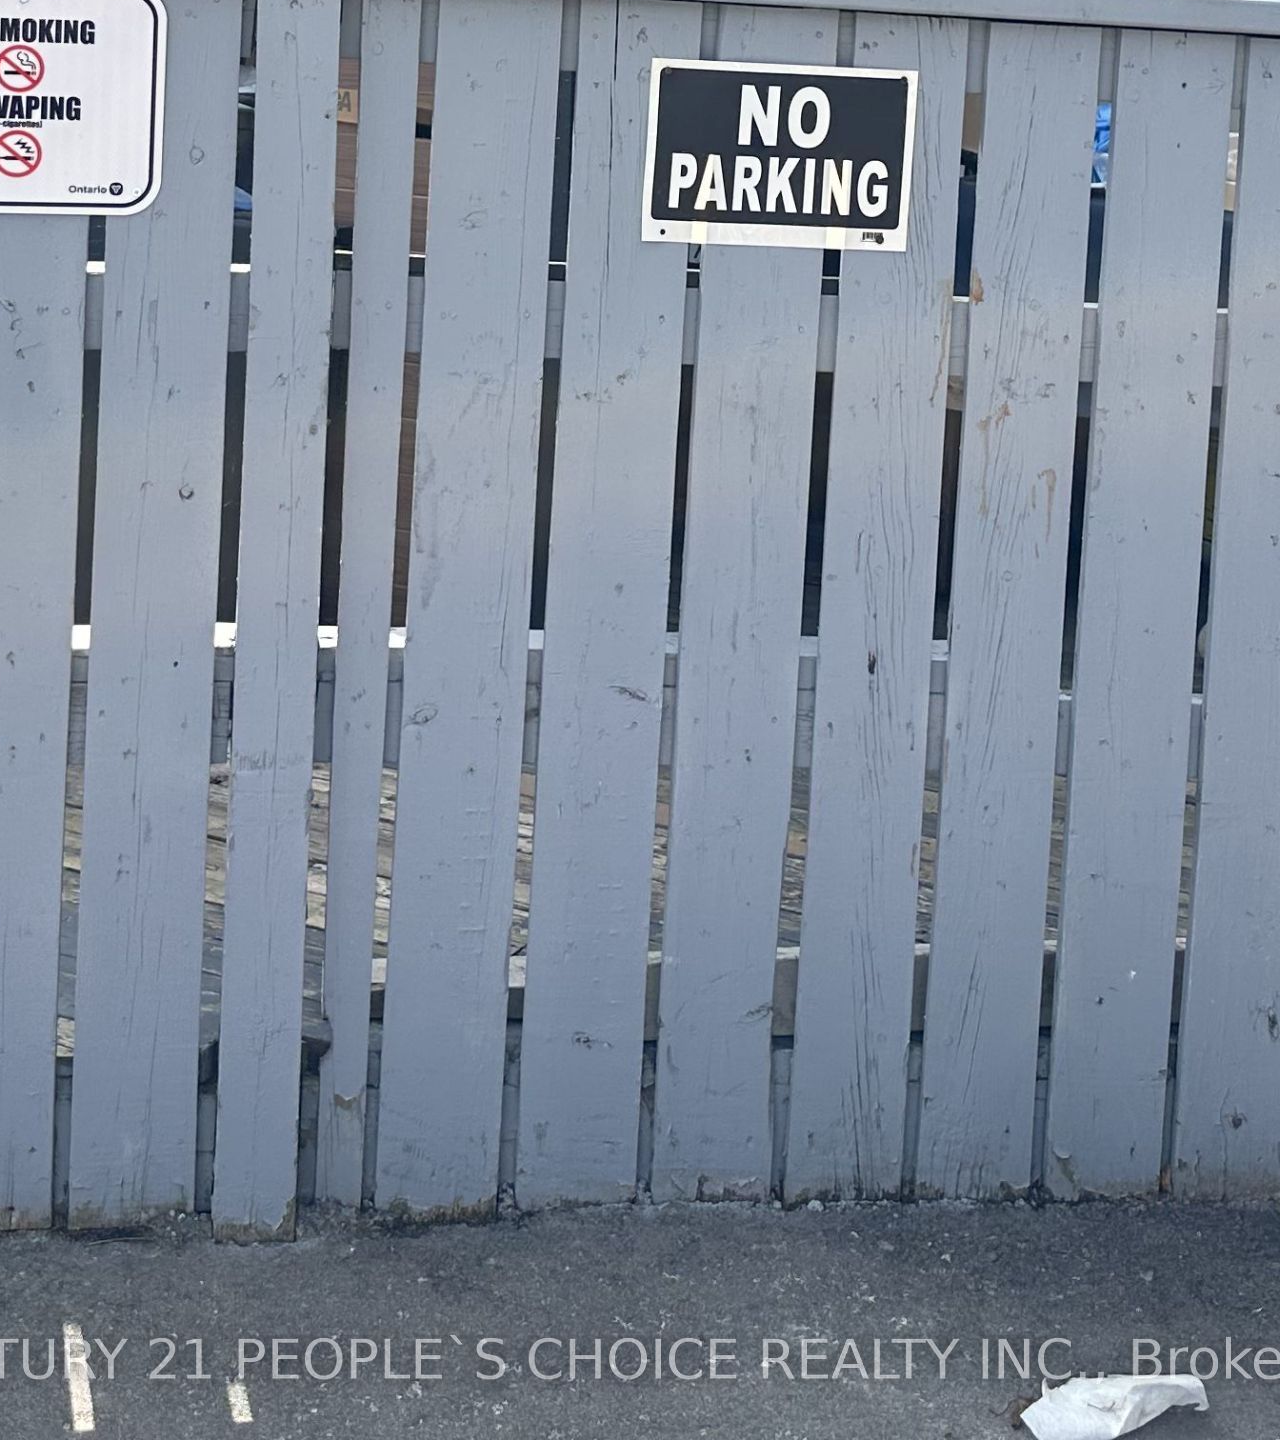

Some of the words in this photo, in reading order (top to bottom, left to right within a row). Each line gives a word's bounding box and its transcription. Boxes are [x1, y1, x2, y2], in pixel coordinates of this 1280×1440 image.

[737, 84, 831, 149] NO
[68, 185, 107, 194] Ontario
[667, 152, 889, 218] PARKING
